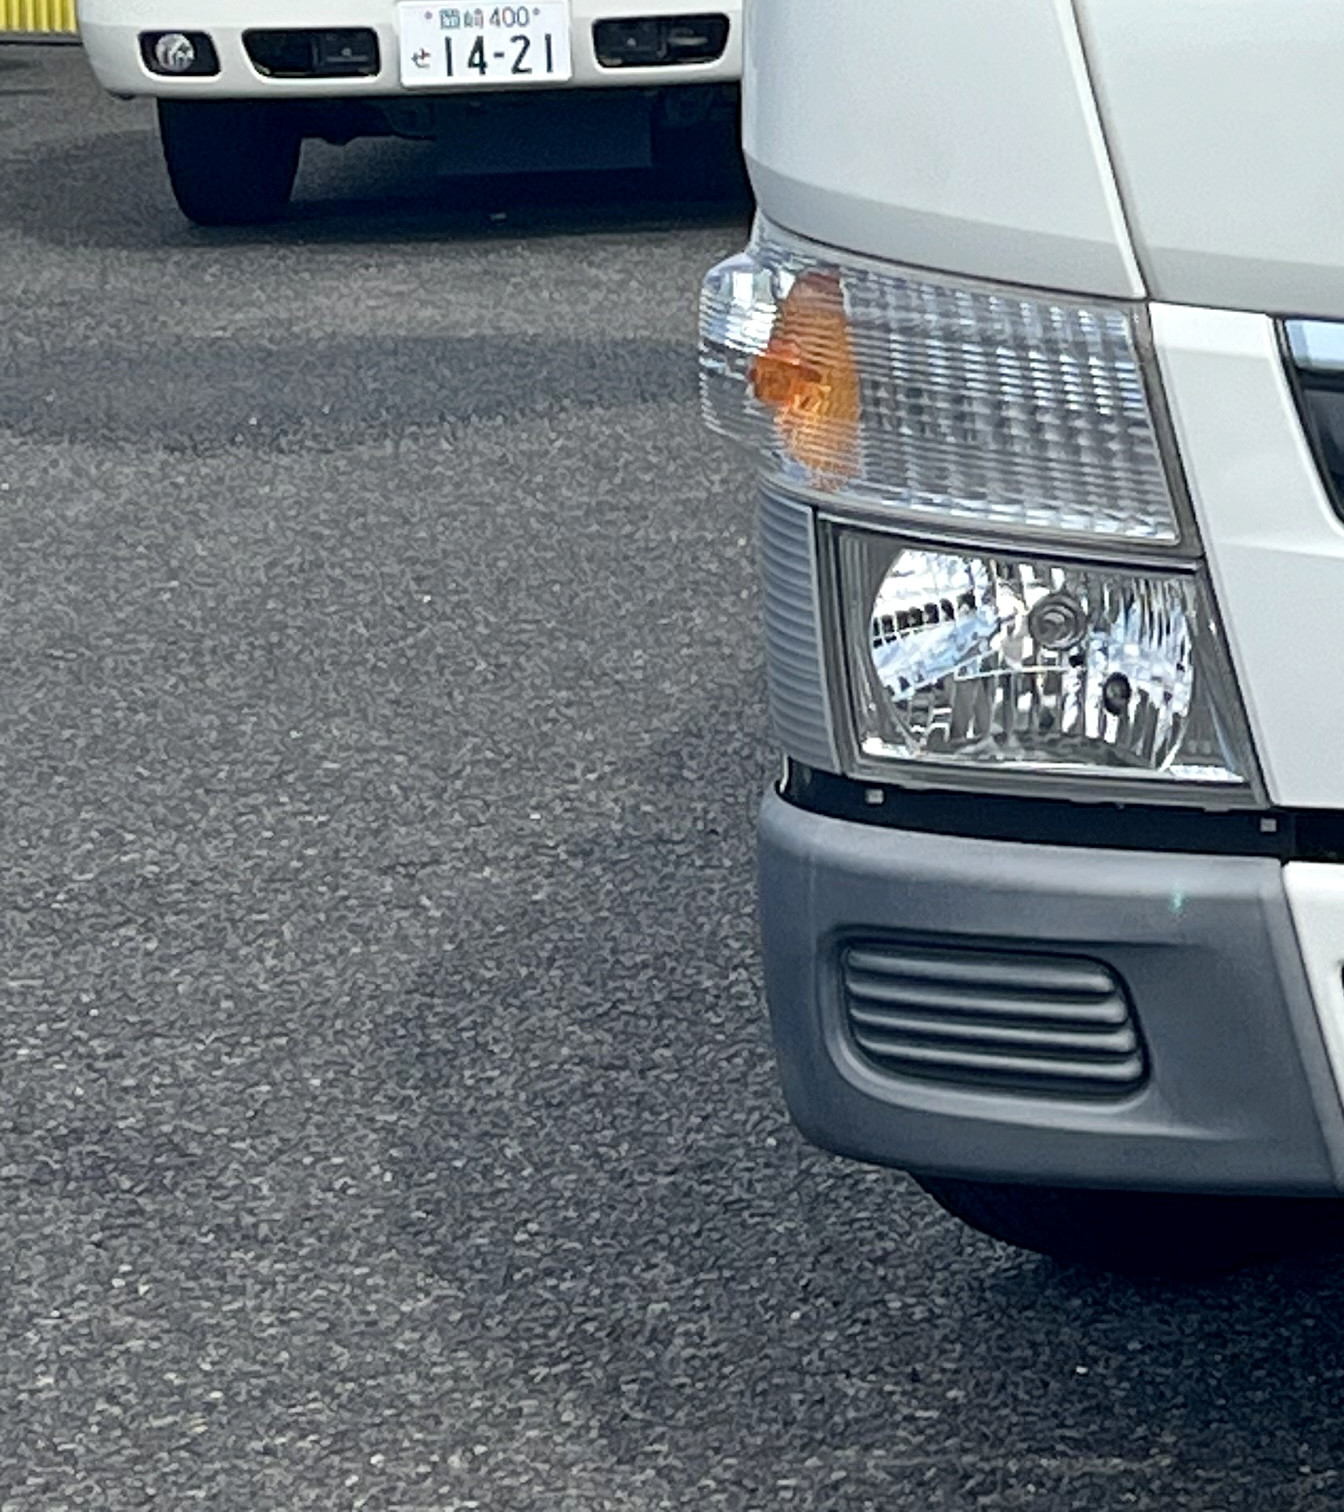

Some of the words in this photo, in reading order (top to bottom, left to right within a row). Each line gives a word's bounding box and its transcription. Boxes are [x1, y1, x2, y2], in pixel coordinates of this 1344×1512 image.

[489, 5, 529, 28] 400
[411, 48, 431, 69] せ
[444, 32, 554, 77] 14-21
